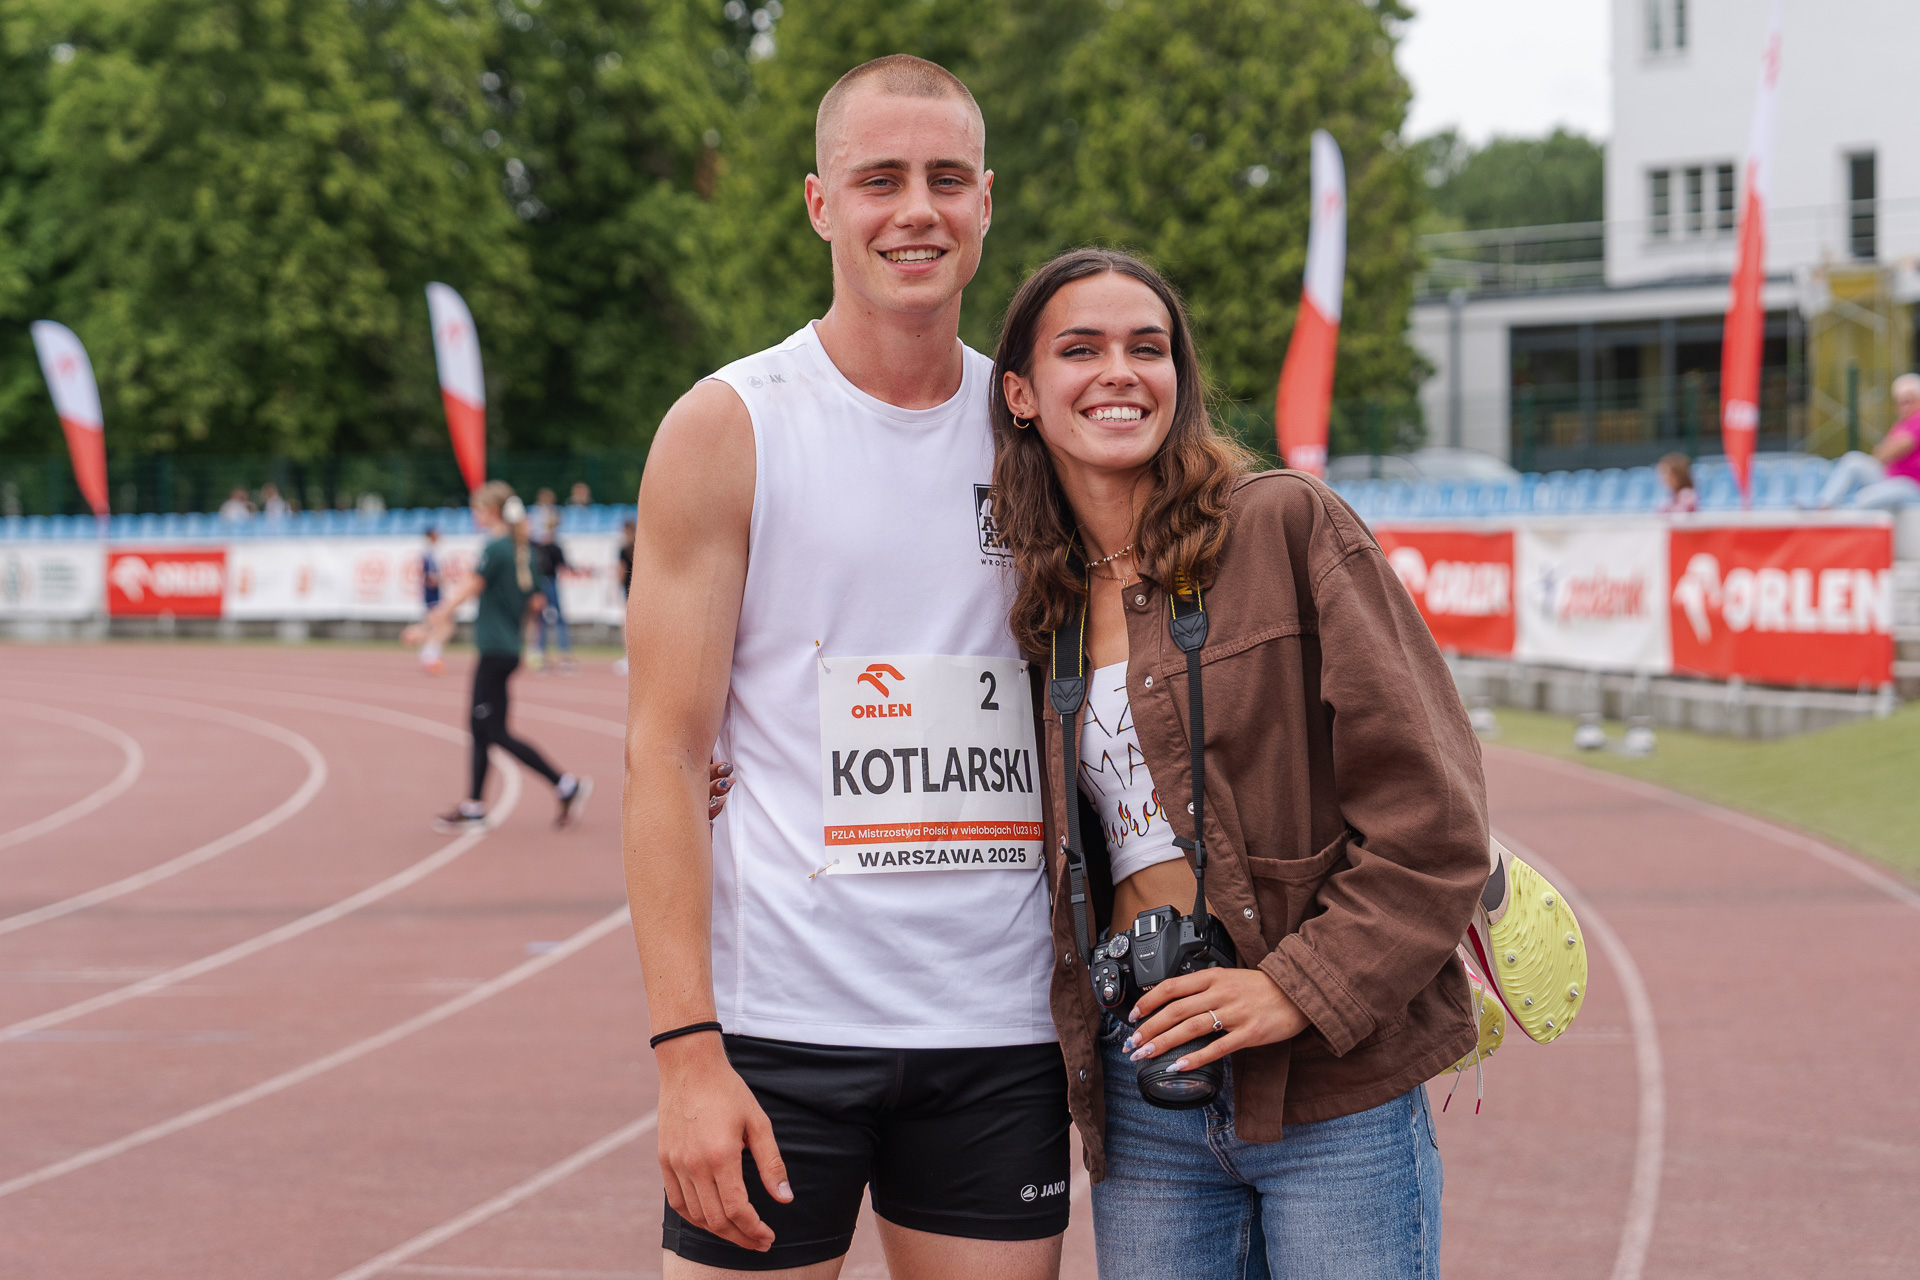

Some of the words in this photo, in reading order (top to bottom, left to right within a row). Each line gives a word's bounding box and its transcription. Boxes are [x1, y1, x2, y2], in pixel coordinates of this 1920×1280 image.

[1722, 566, 1893, 635] ORLEN
[979, 670, 1000, 711] 2
[851, 703, 912, 719] ORLEN
[831, 747, 1034, 797] KOTLARSKI
[831, 829, 856, 840] PZLA
[858, 827, 920, 839] Mistrzostwa
[923, 825, 949, 836] Polski
[960, 825, 1012, 837] wielobojach
[1013, 824, 1029, 836] (U23
[1033, 824, 1041, 836] S)
[857, 848, 985, 867] WARSZAWA
[987, 847, 1027, 863] 2025
[1040, 1180, 1066, 1197] JAKO
